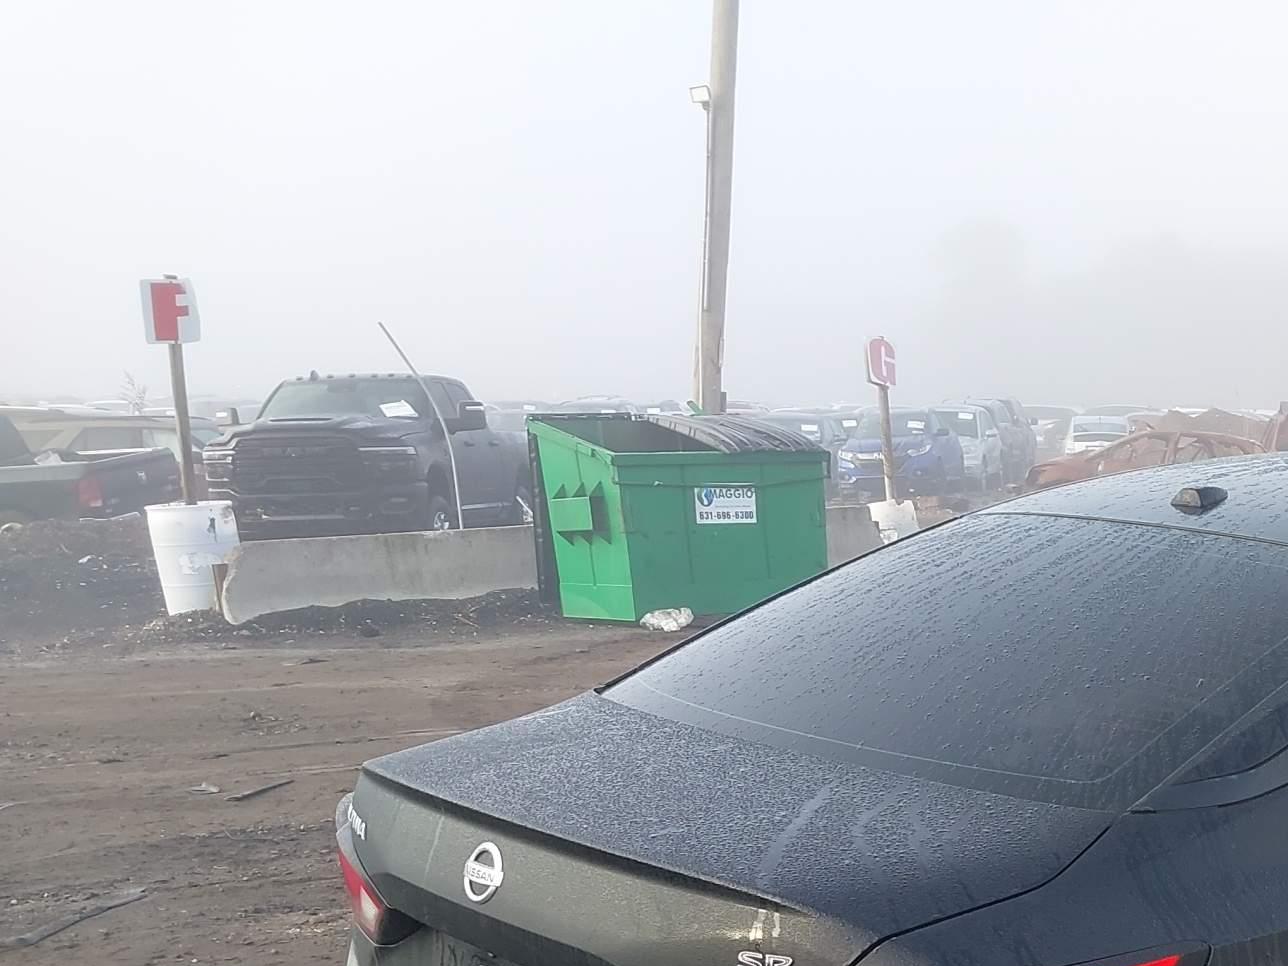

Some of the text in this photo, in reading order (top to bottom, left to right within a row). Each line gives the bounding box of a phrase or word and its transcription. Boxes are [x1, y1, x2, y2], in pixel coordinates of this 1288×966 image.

[150, 282, 189, 341] F
[869, 339, 897, 385] G
[708, 487, 753, 499] MAGGIO
